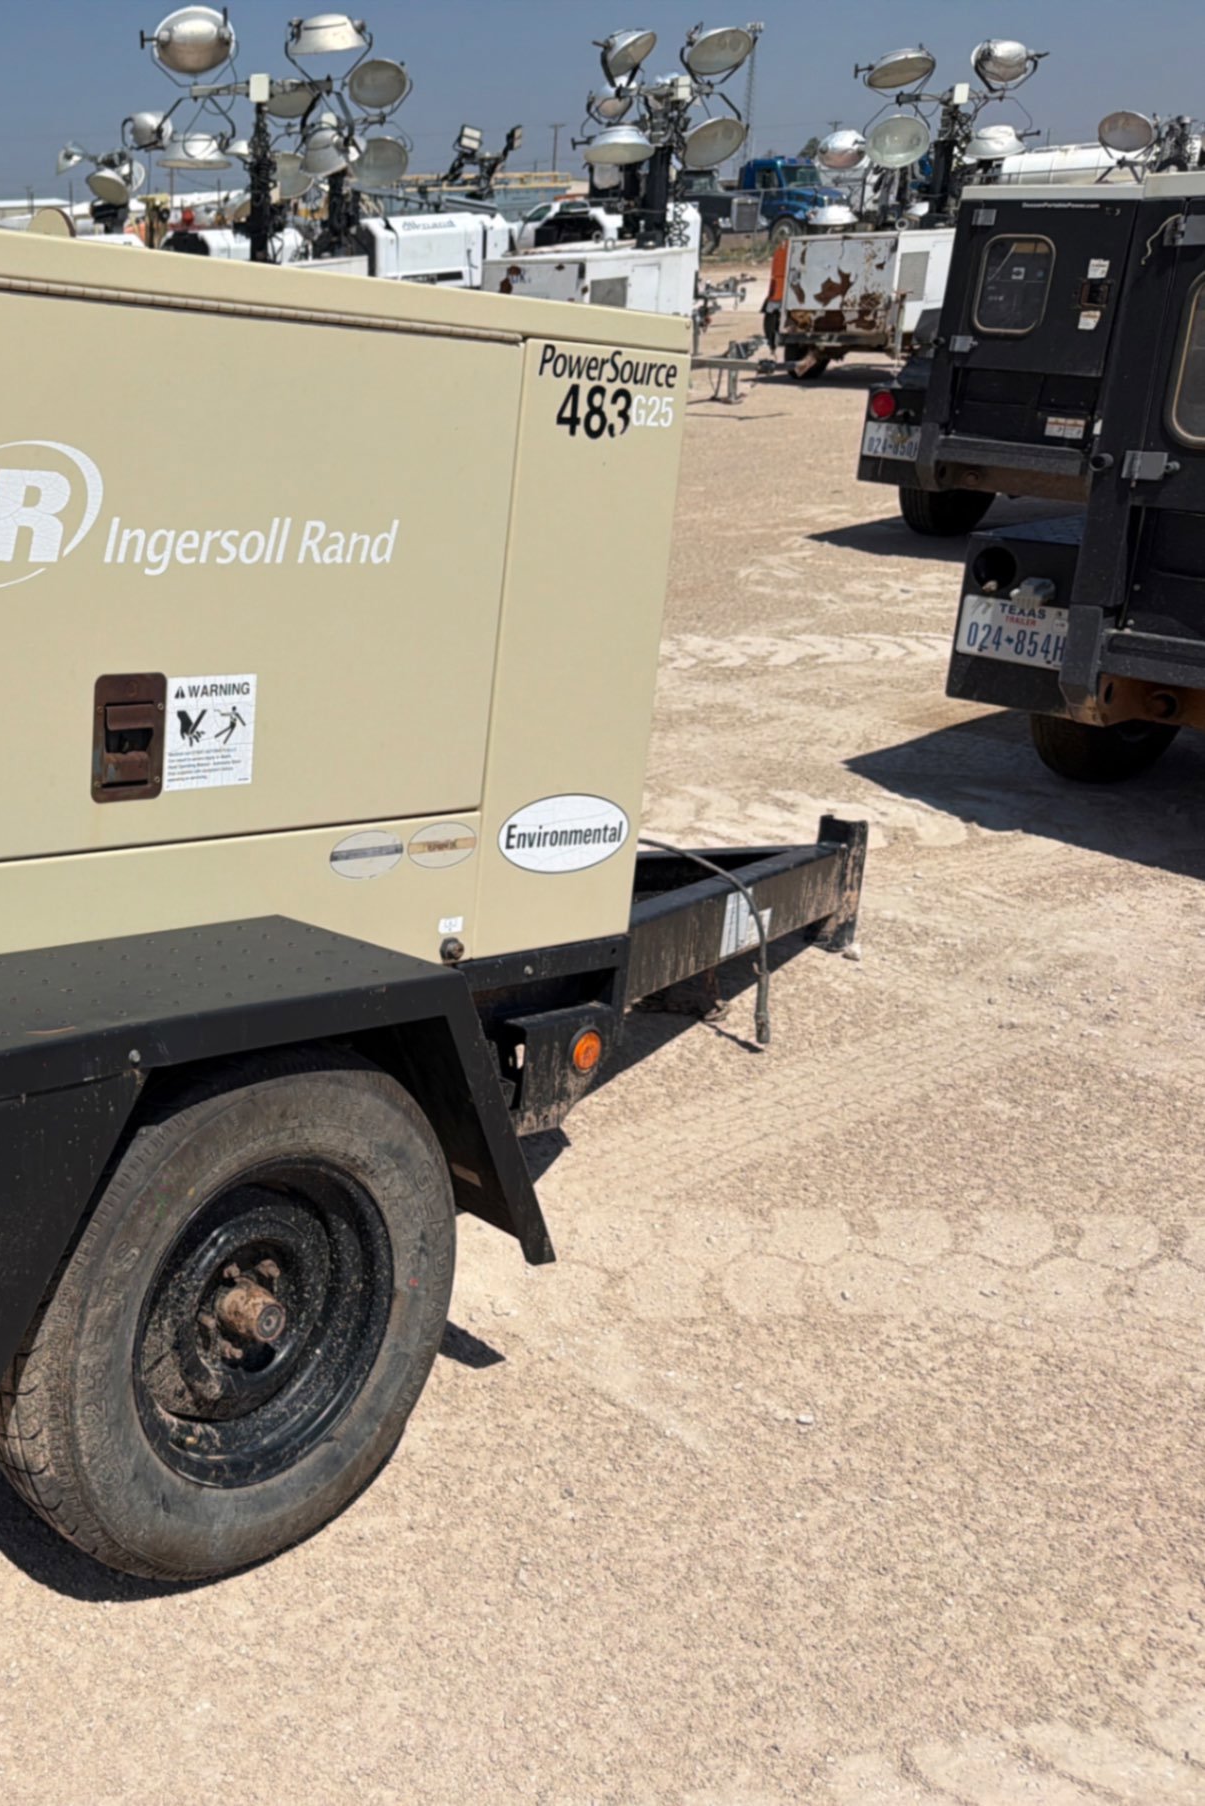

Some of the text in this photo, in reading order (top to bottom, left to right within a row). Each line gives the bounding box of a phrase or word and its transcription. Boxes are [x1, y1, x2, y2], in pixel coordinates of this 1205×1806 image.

[539, 344, 678, 388] PowerSource
[556, 384, 674, 440] 483 G25
[103, 516, 400, 576] Ingersoll Rand
[1000, 602, 1046, 620] TEXAS
[188, 681, 251, 699] WARNING
[505, 820, 624, 851] Environmental
